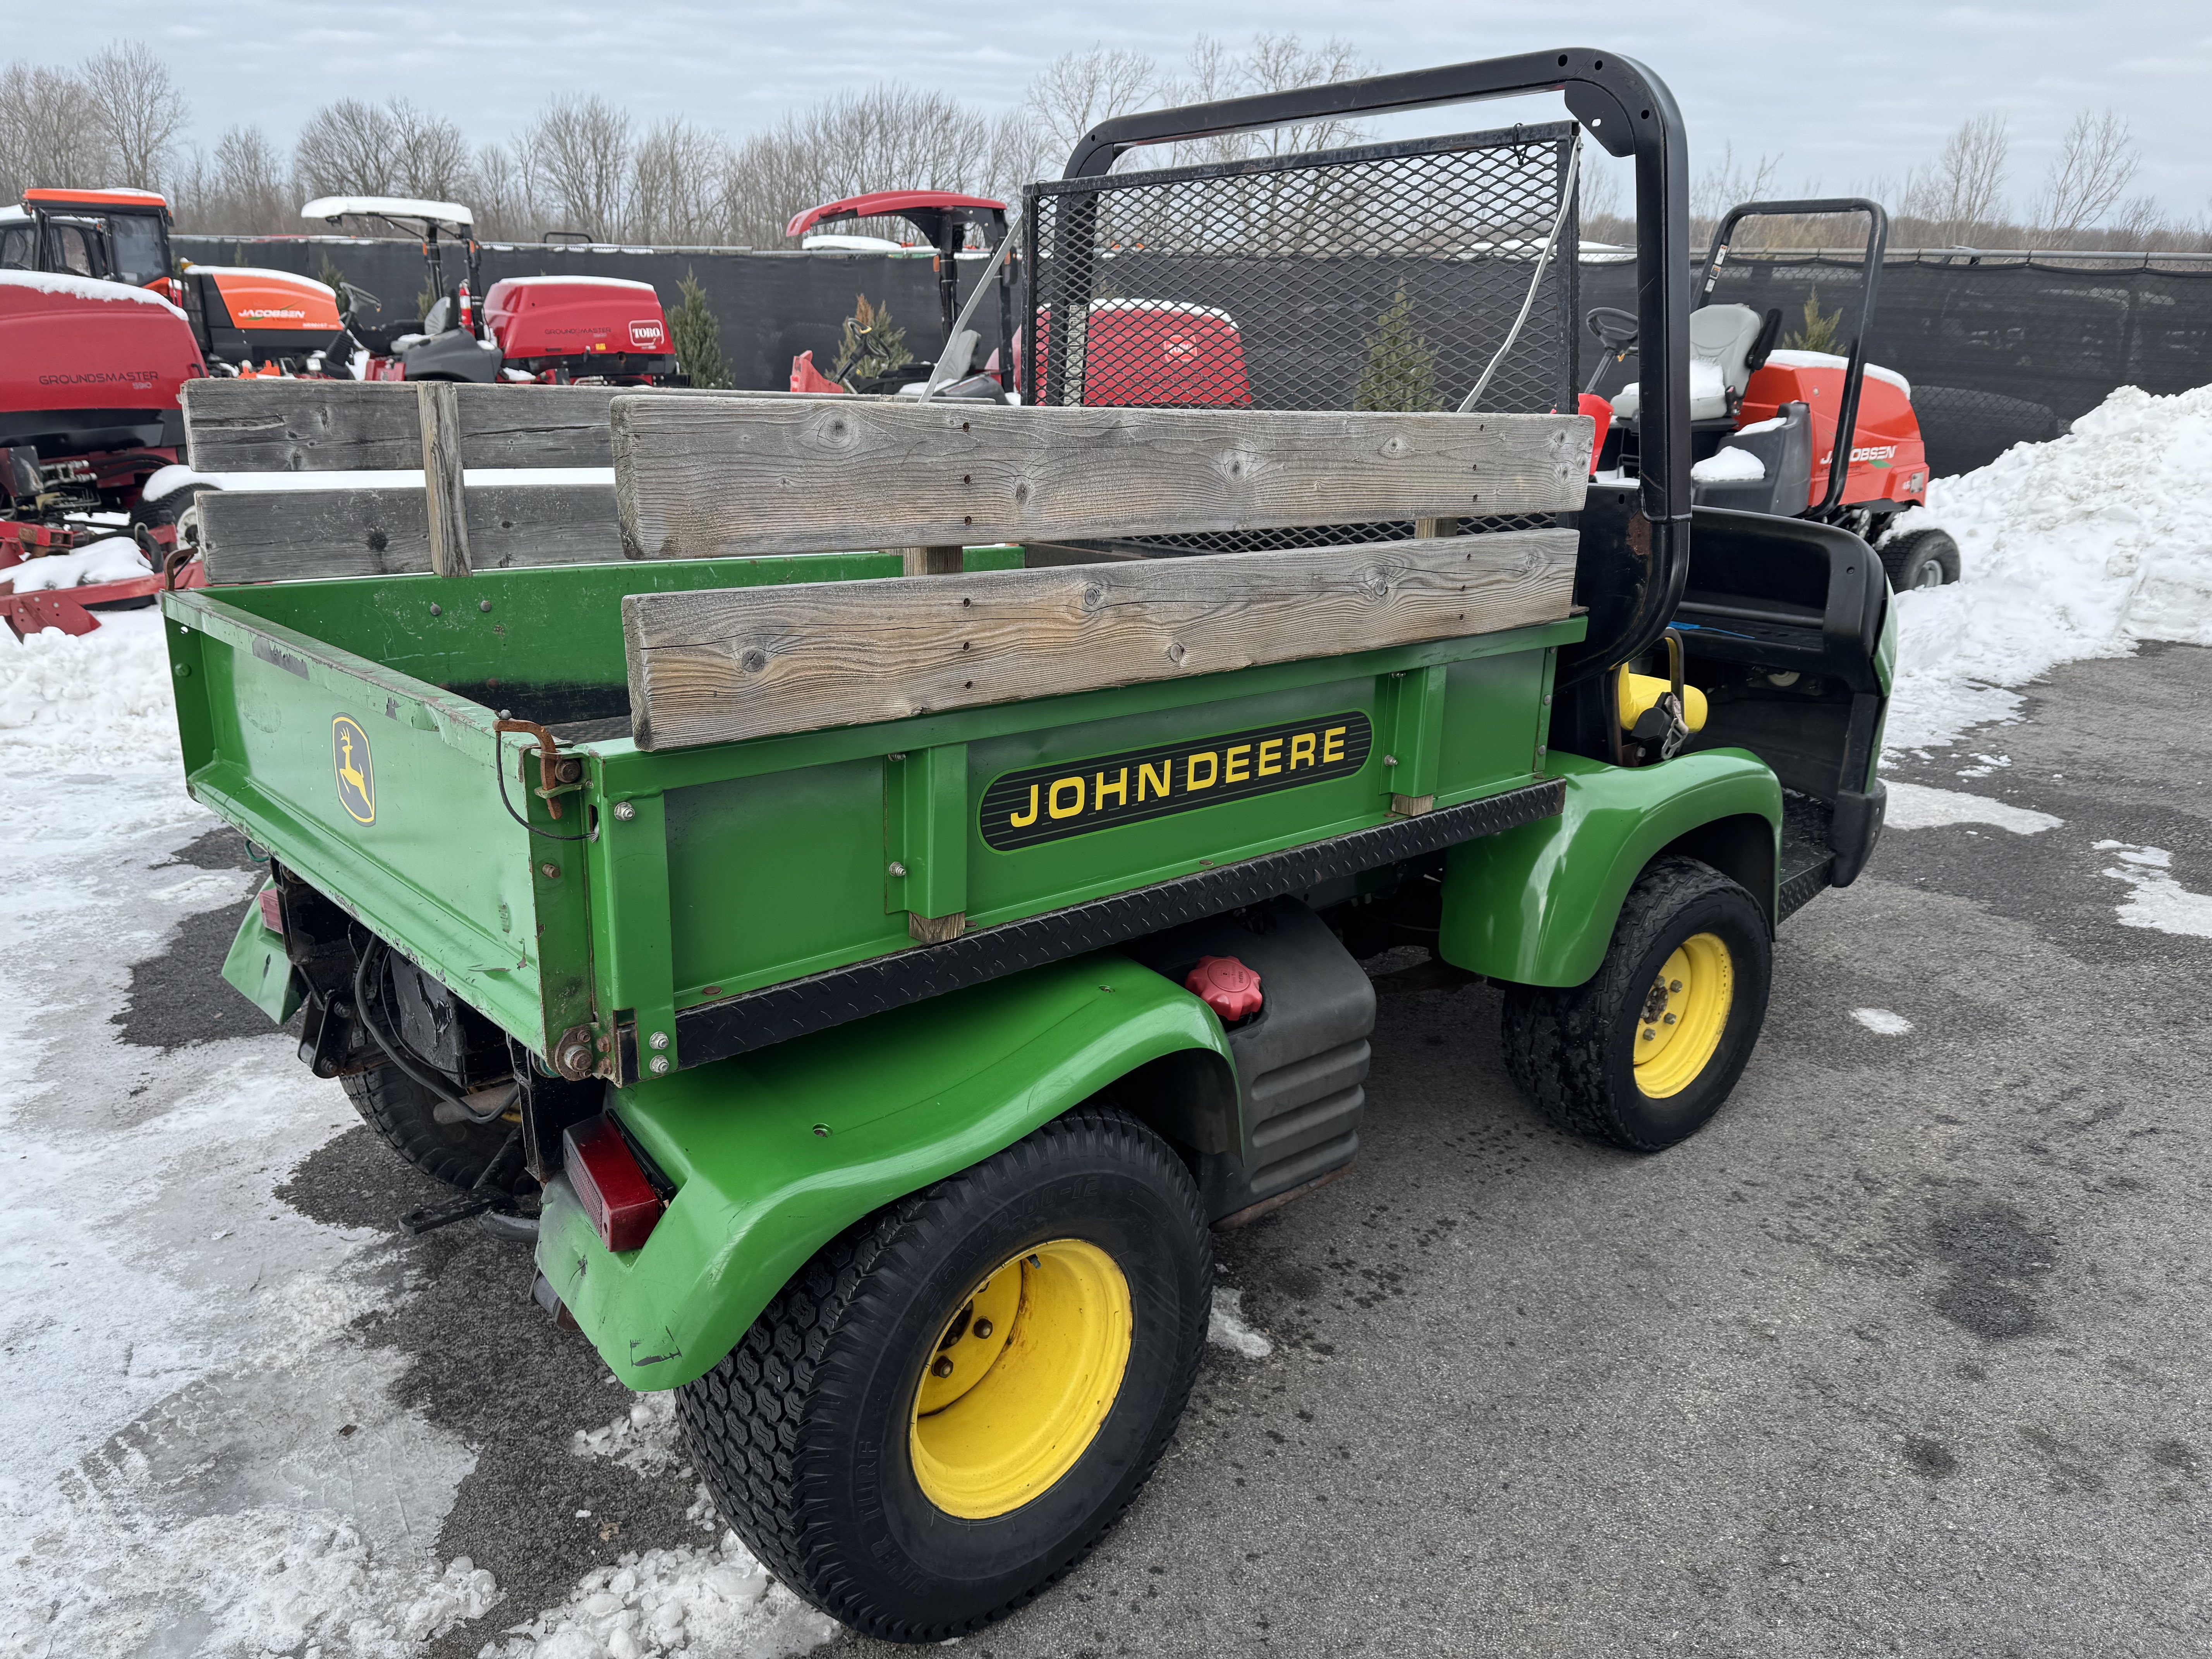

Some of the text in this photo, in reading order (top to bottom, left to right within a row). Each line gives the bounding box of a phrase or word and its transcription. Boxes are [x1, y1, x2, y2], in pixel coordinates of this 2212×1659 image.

[238, 309, 306, 318] JACOBSEN
[544, 327, 611, 335] GROUNDMASTER
[632, 327, 661, 338] TORO
[39, 371, 159, 385] GROUNDSMASTER
[1820, 446, 1897, 464] JOBSEN
[1010, 726, 1346, 828] JOHN DEERE
[855, 1441, 882, 1525] TURF
